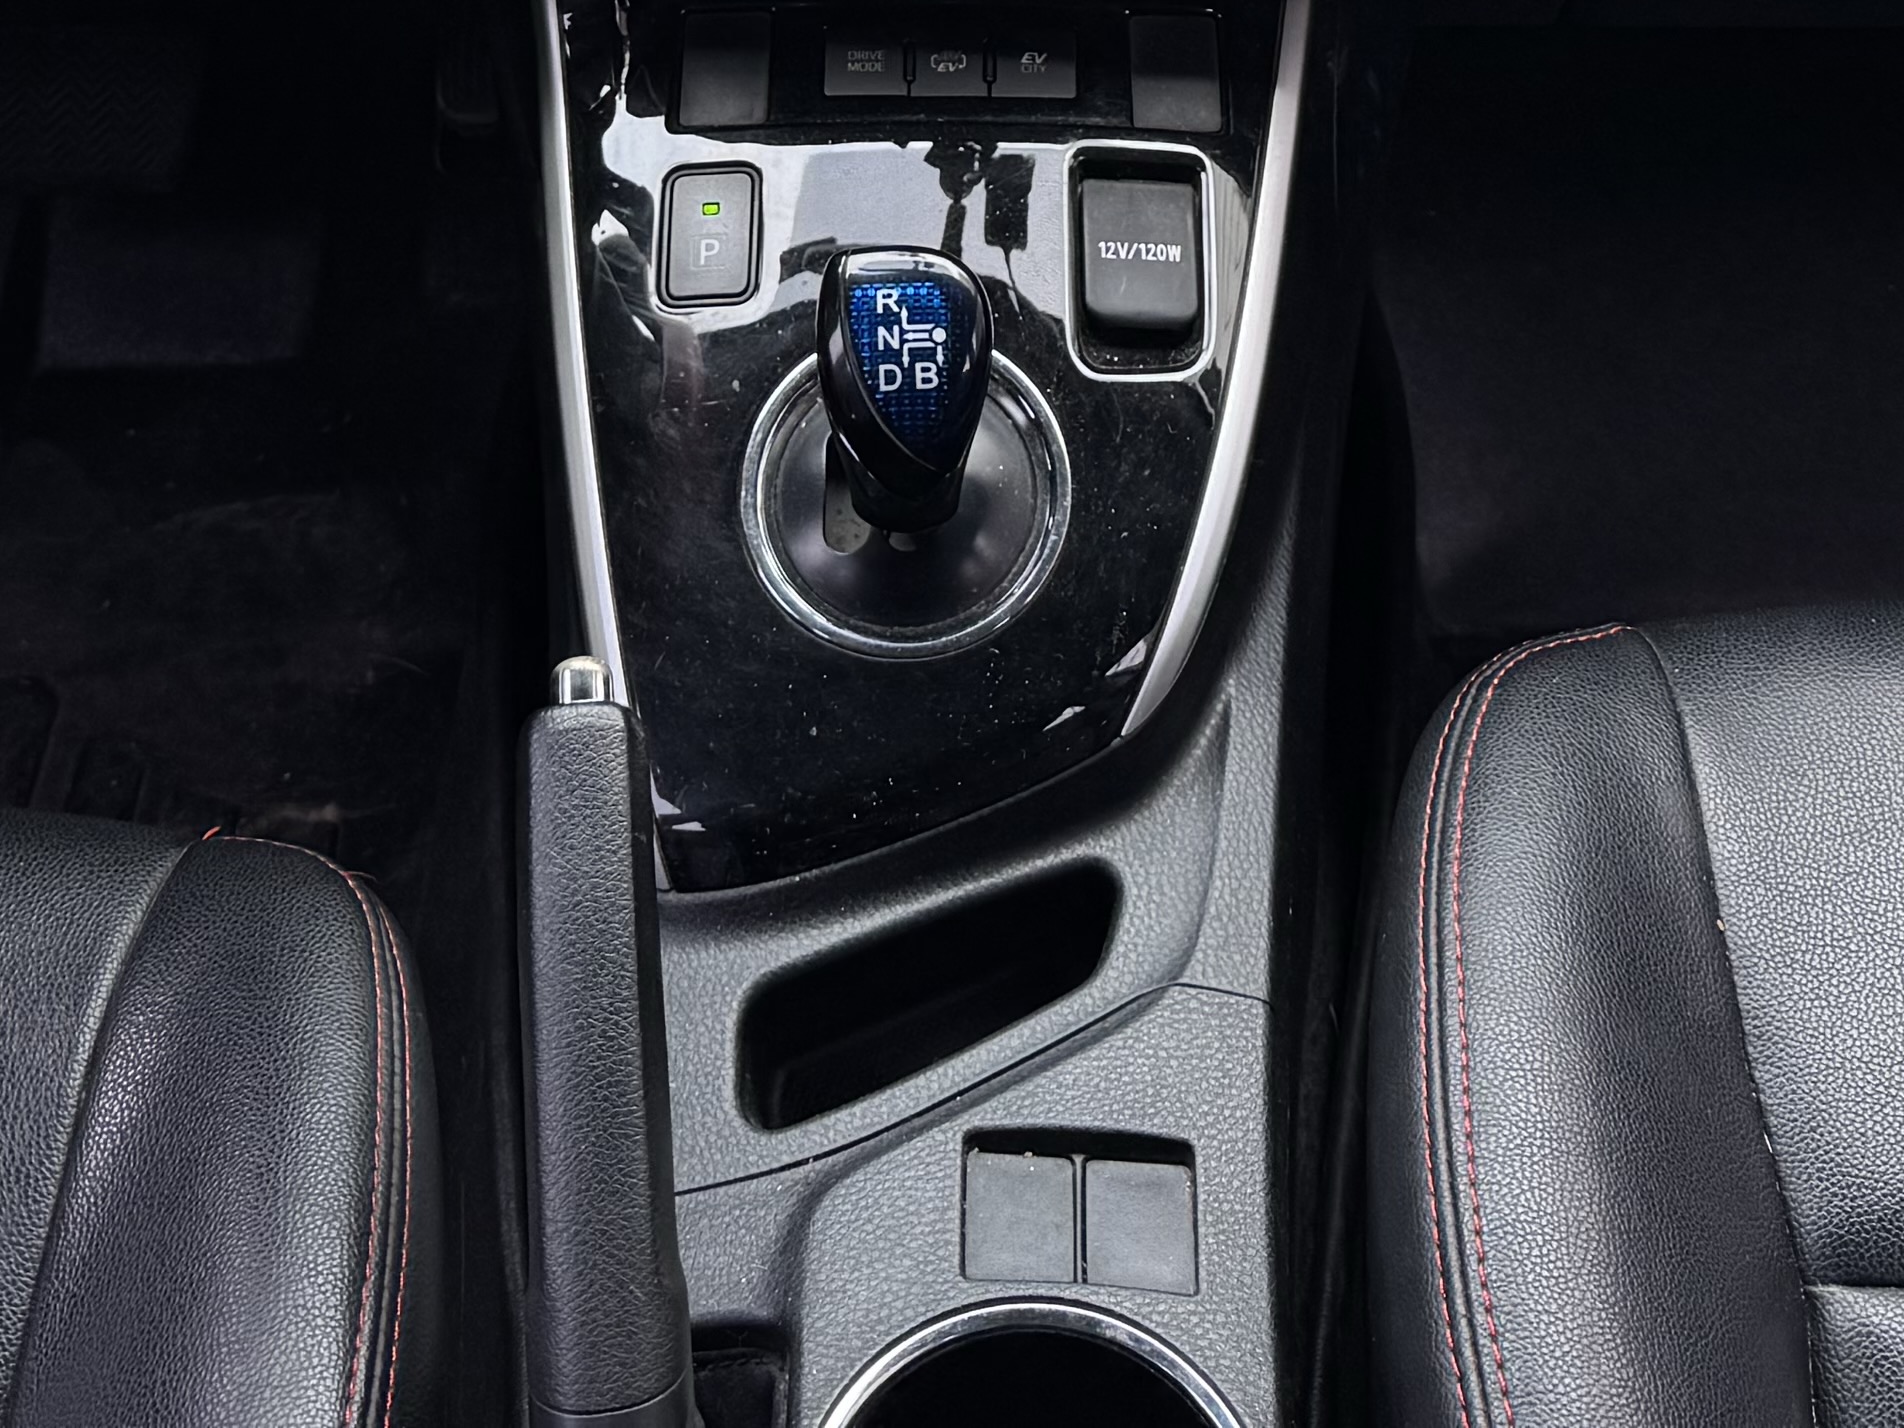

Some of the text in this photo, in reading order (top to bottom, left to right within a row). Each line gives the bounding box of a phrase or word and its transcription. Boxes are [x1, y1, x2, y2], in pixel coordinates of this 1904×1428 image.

[847, 50, 886, 61] DRIVE
[1020, 51, 1048, 64] EV
[847, 61, 886, 73] MODE
[936, 61, 959, 73] EV
[1020, 63, 1047, 74] CITY
[700, 238, 720, 266] P
[1097, 240, 1183, 264] 12V/120W
[875, 288, 899, 313] R
[877, 325, 902, 351] N
[879, 362, 940, 392] D B
